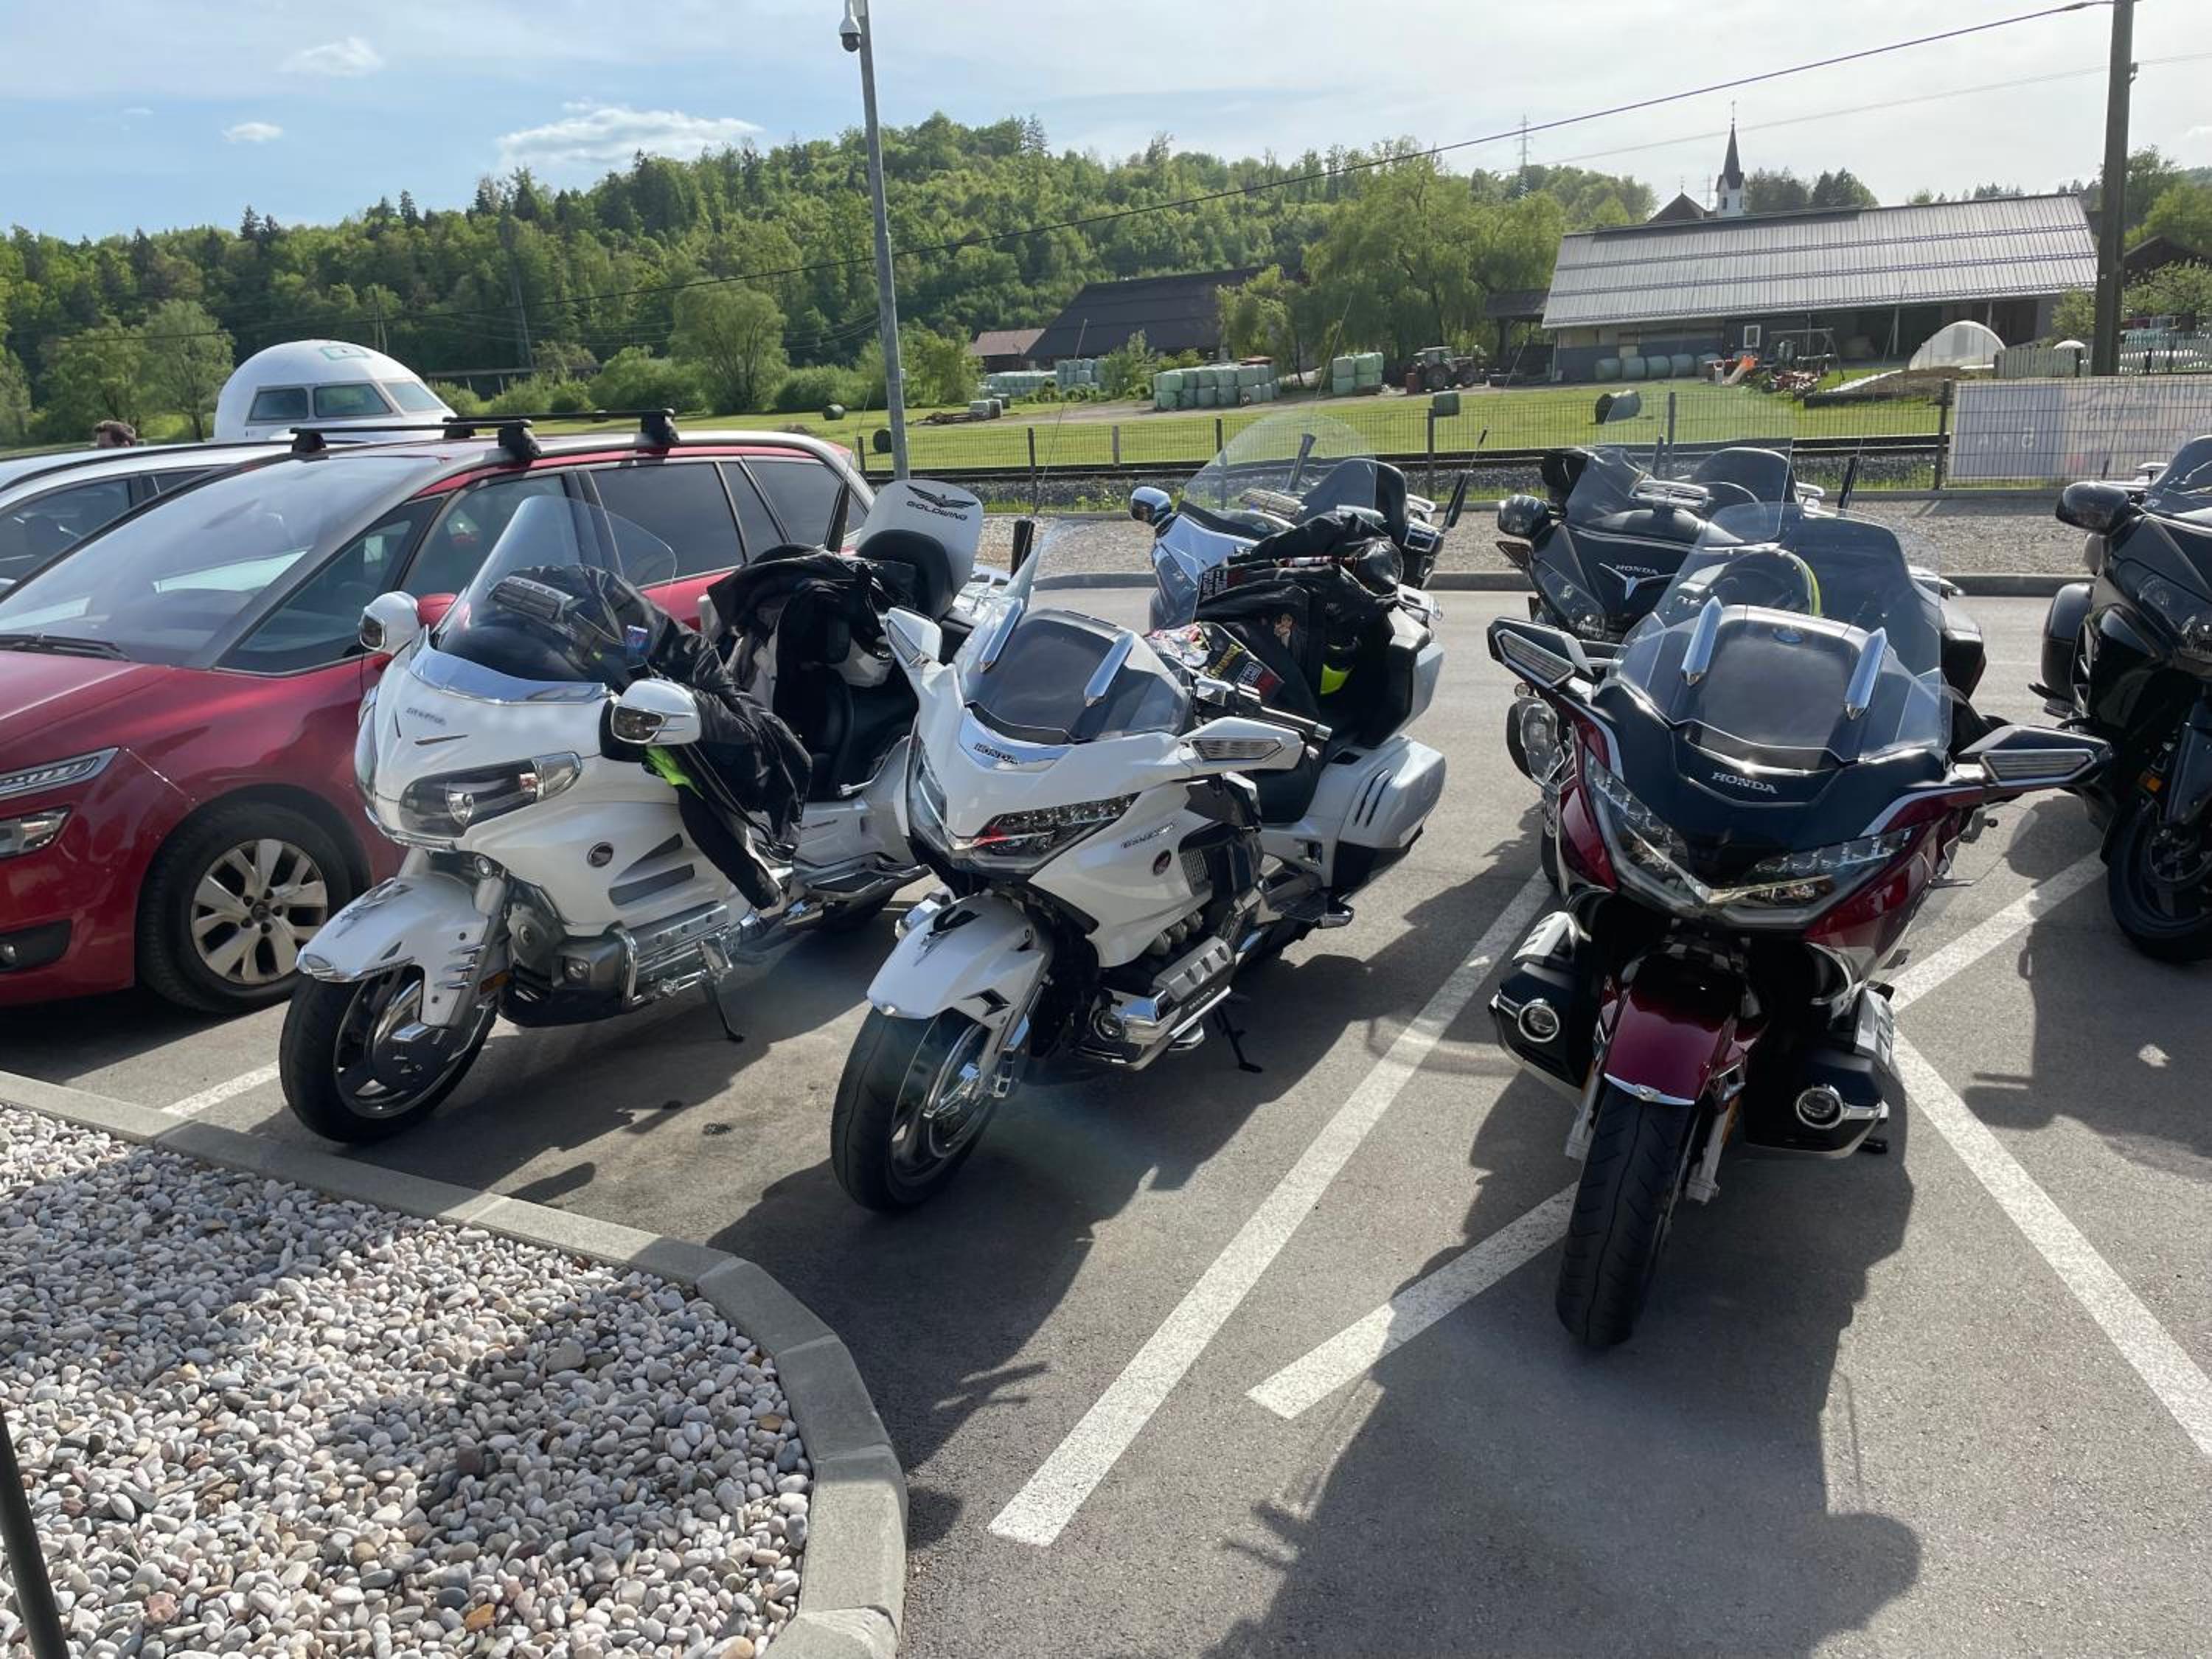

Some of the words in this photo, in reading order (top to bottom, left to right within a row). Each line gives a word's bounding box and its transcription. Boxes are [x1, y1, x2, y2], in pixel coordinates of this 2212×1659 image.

[906, 501, 967, 521] GOLDWING
[1615, 565, 1659, 576] HONDA
[1711, 772, 1778, 793] HONDA
